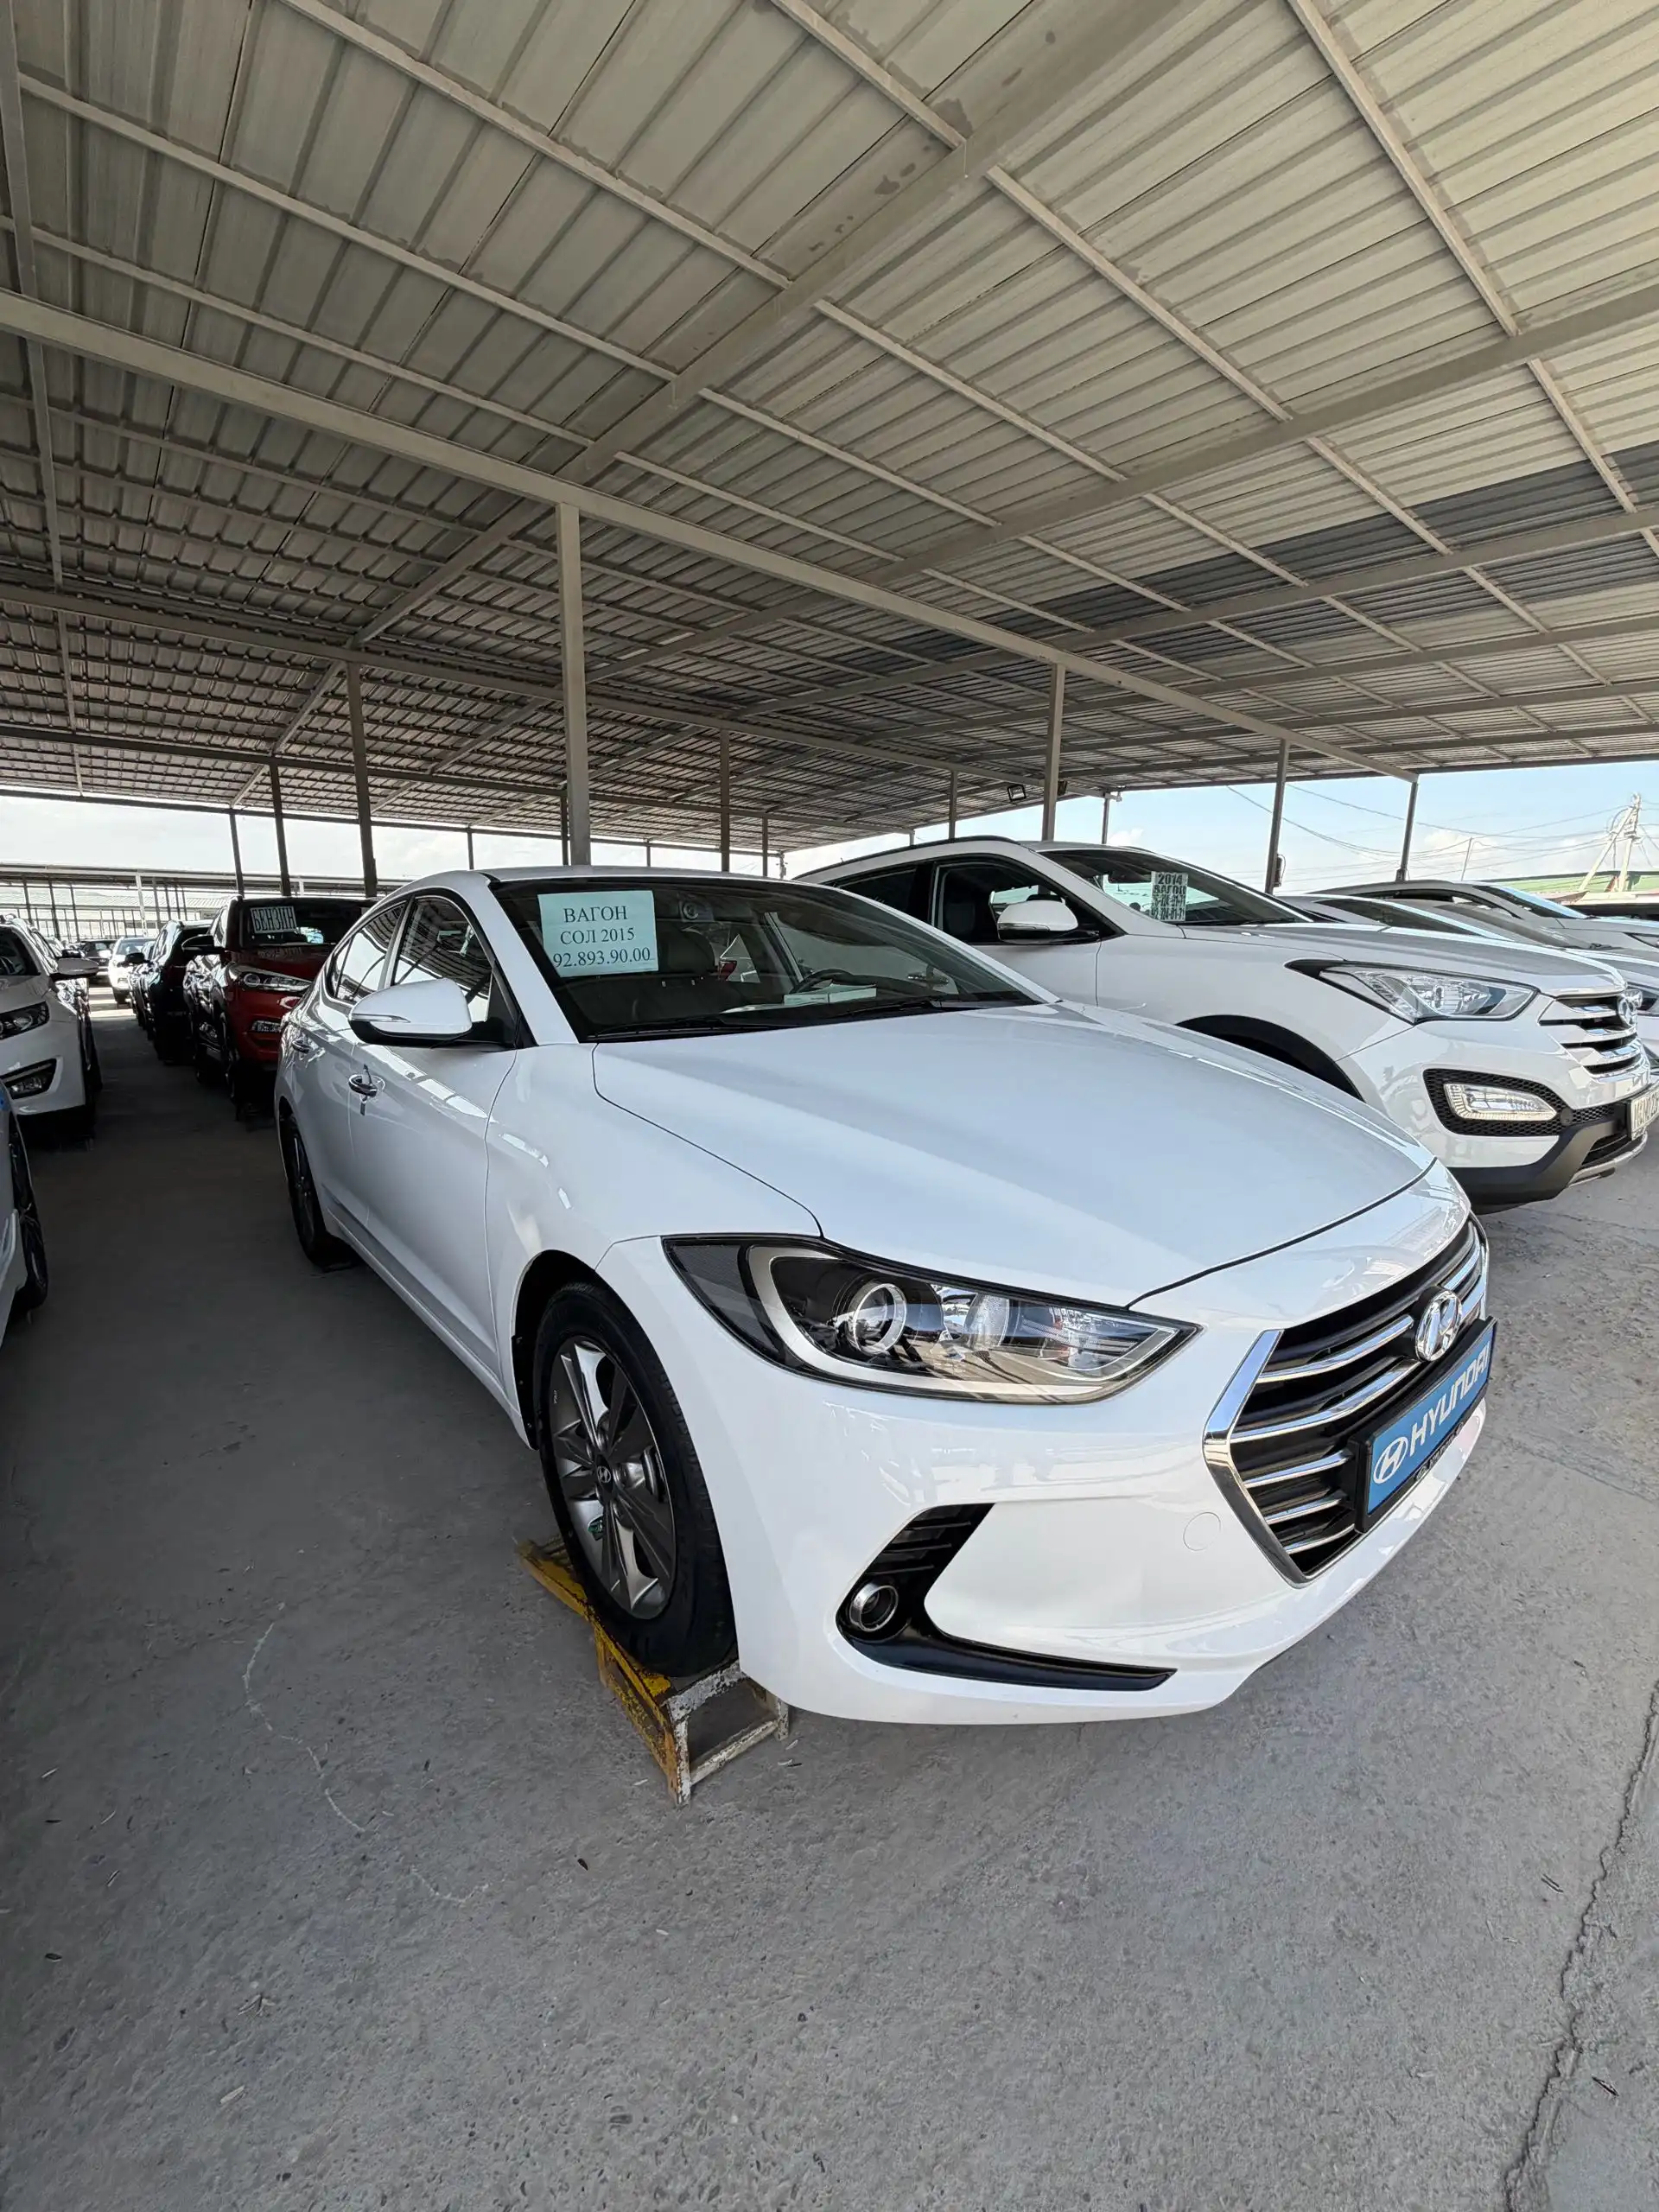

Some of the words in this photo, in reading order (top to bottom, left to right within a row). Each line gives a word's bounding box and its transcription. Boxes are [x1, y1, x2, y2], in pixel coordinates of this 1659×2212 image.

[252, 907, 295, 931] БЕНЗИН
[563, 906, 628, 923] ВАГОН
[561, 930, 596, 945] СОЛ
[601, 927, 635, 943] 2015
[553, 947, 651, 968] 92.893.90.00
[1409, 1340, 1491, 1457] HYUNDAI
